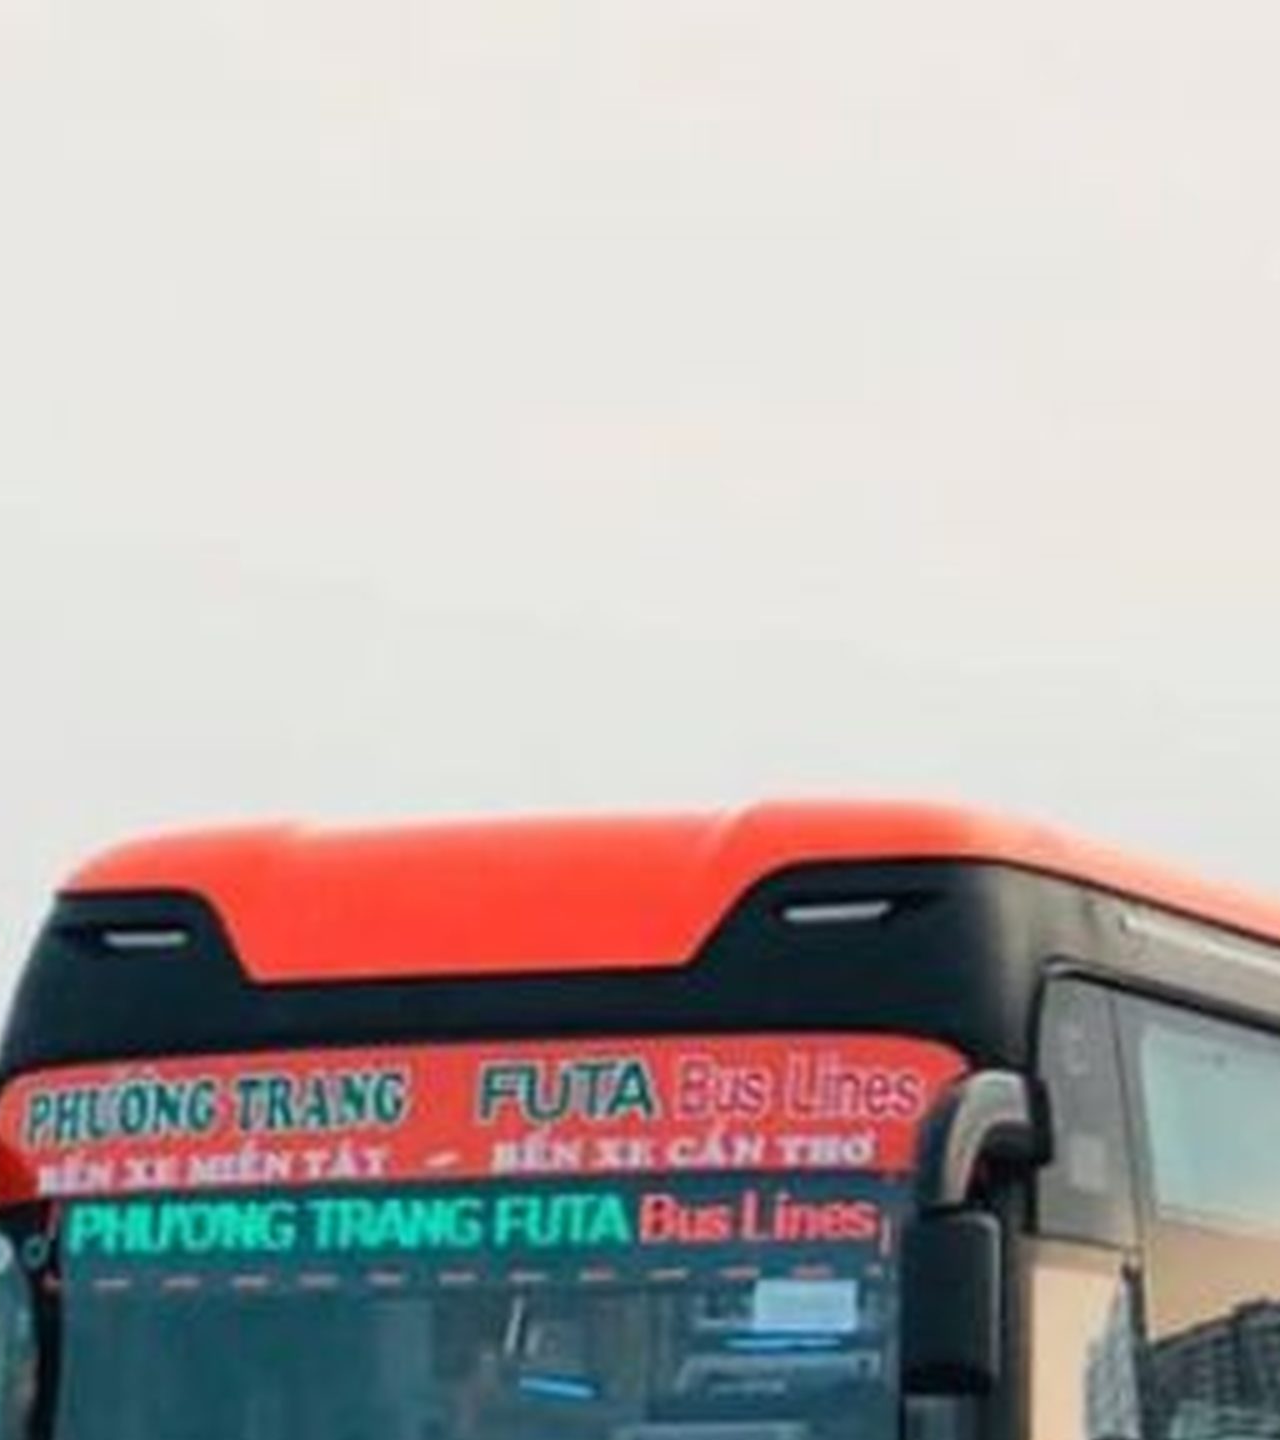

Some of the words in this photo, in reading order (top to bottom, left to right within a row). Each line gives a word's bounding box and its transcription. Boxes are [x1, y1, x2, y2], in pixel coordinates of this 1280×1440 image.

[231, 1070, 411, 1132] TRANG
[476, 1060, 662, 1126] FUTA
[672, 1054, 770, 1120] Bus
[783, 1050, 924, 1120] Lines
[307, 1198, 486, 1252] TRANG
[493, 1192, 630, 1250] FUTA
[639, 1192, 732, 1244] Bus
[740, 1190, 880, 1242] Lines
